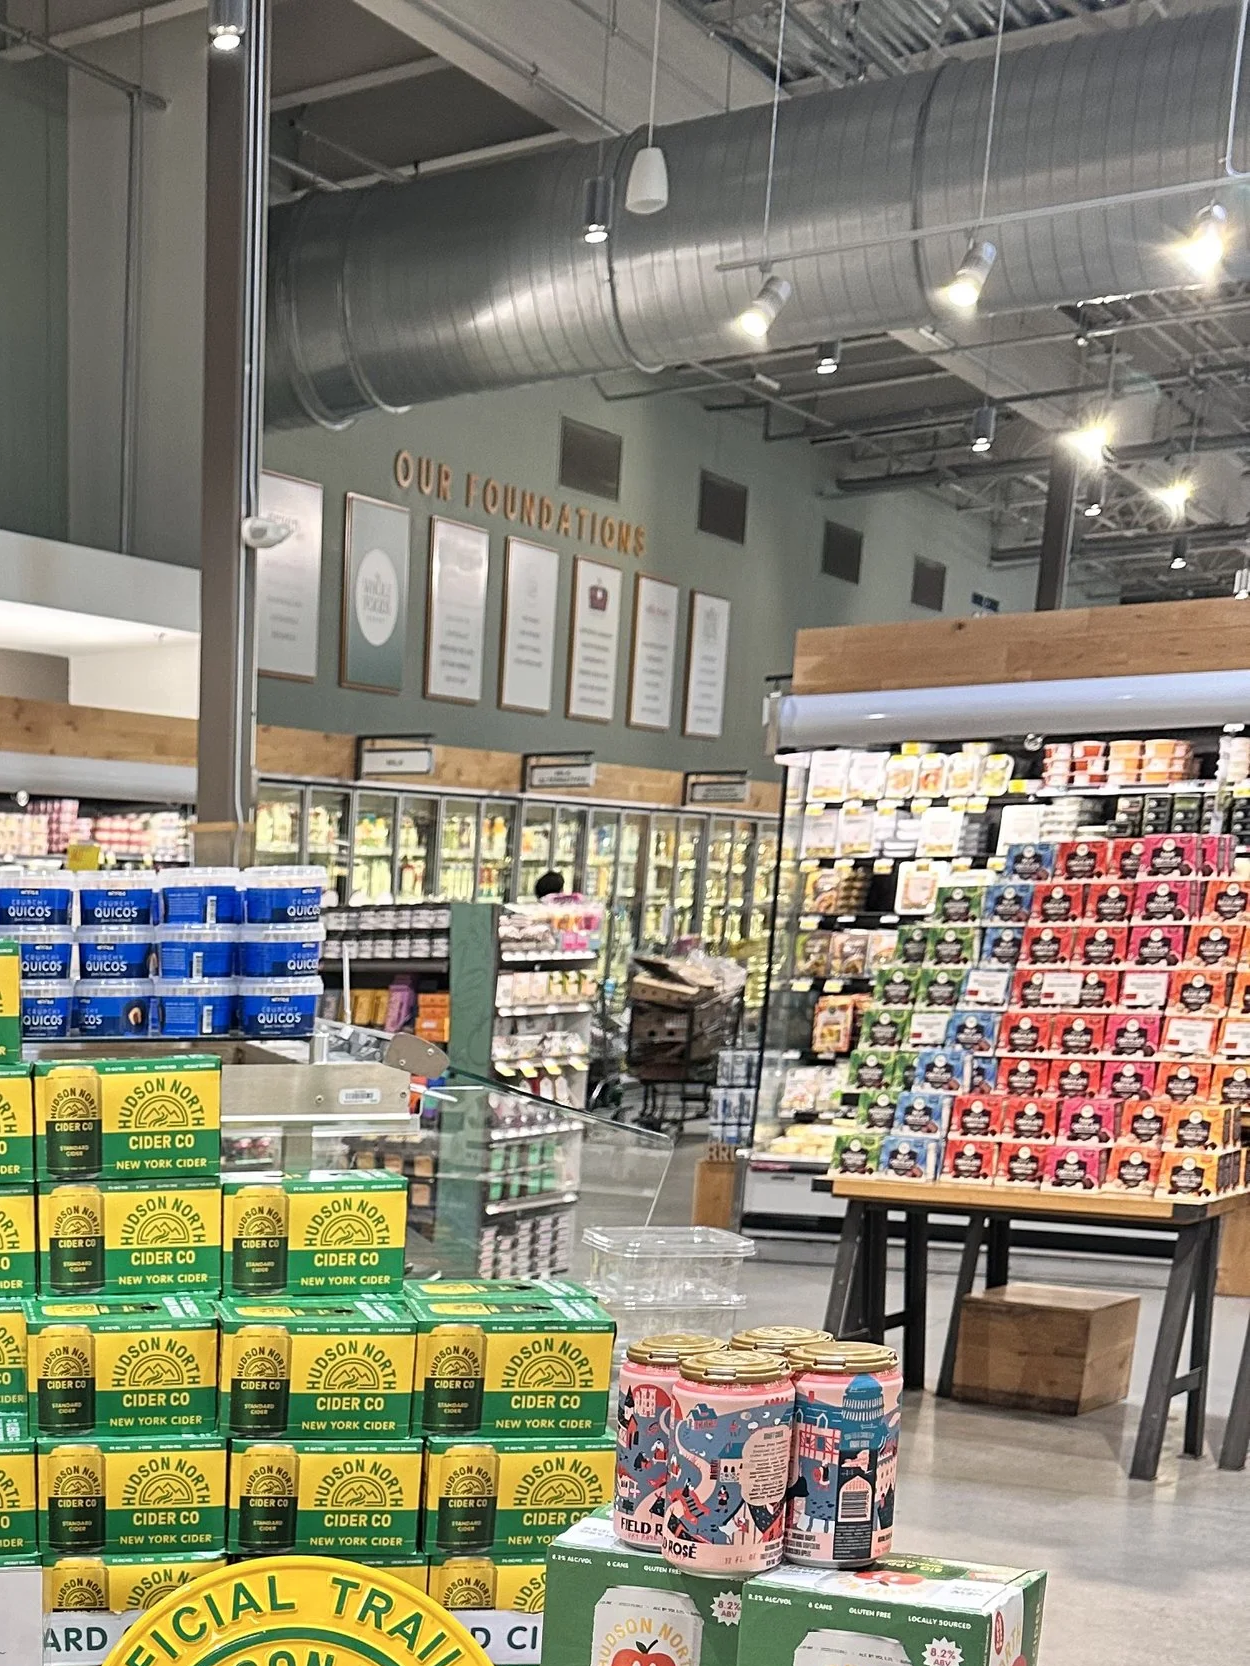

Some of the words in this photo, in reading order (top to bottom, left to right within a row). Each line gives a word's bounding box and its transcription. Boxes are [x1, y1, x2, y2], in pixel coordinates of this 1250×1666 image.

[395, 450, 451, 500] OUR
[466, 472, 646, 557] FOUNDATIONS
[8, 906, 51, 918] QUICOS
[94, 906, 138, 919] QUICOS
[21, 960, 62, 972] QUICOS
[86, 961, 127, 972] QUICOS
[23, 1015, 63, 1026] QUICOS
[258, 1013, 301, 1024] QUICOS
[501, 1338, 553, 1388] HUDSON
[558, 1340, 594, 1388] NORTH
[511, 1396, 555, 1409] CIDER
[560, 1396, 580, 1409] CO
[496, 1420, 521, 1429] NEW
[525, 1420, 554, 1428] YORK
[559, 1420, 592, 1429] CIDER
[620, 1518, 651, 1536] FIELD
[668, 1540, 697, 1559] ROSÉ
[849, 1608, 874, 1617] GLUTEN
[876, 1611, 891, 1619] FREE
[908, 1616, 938, 1626] LOCALLY
[939, 1620, 971, 1630] SOURCED
[930, 1648, 956, 1659] 8.2%
[933, 1658, 951, 1666] ABV
